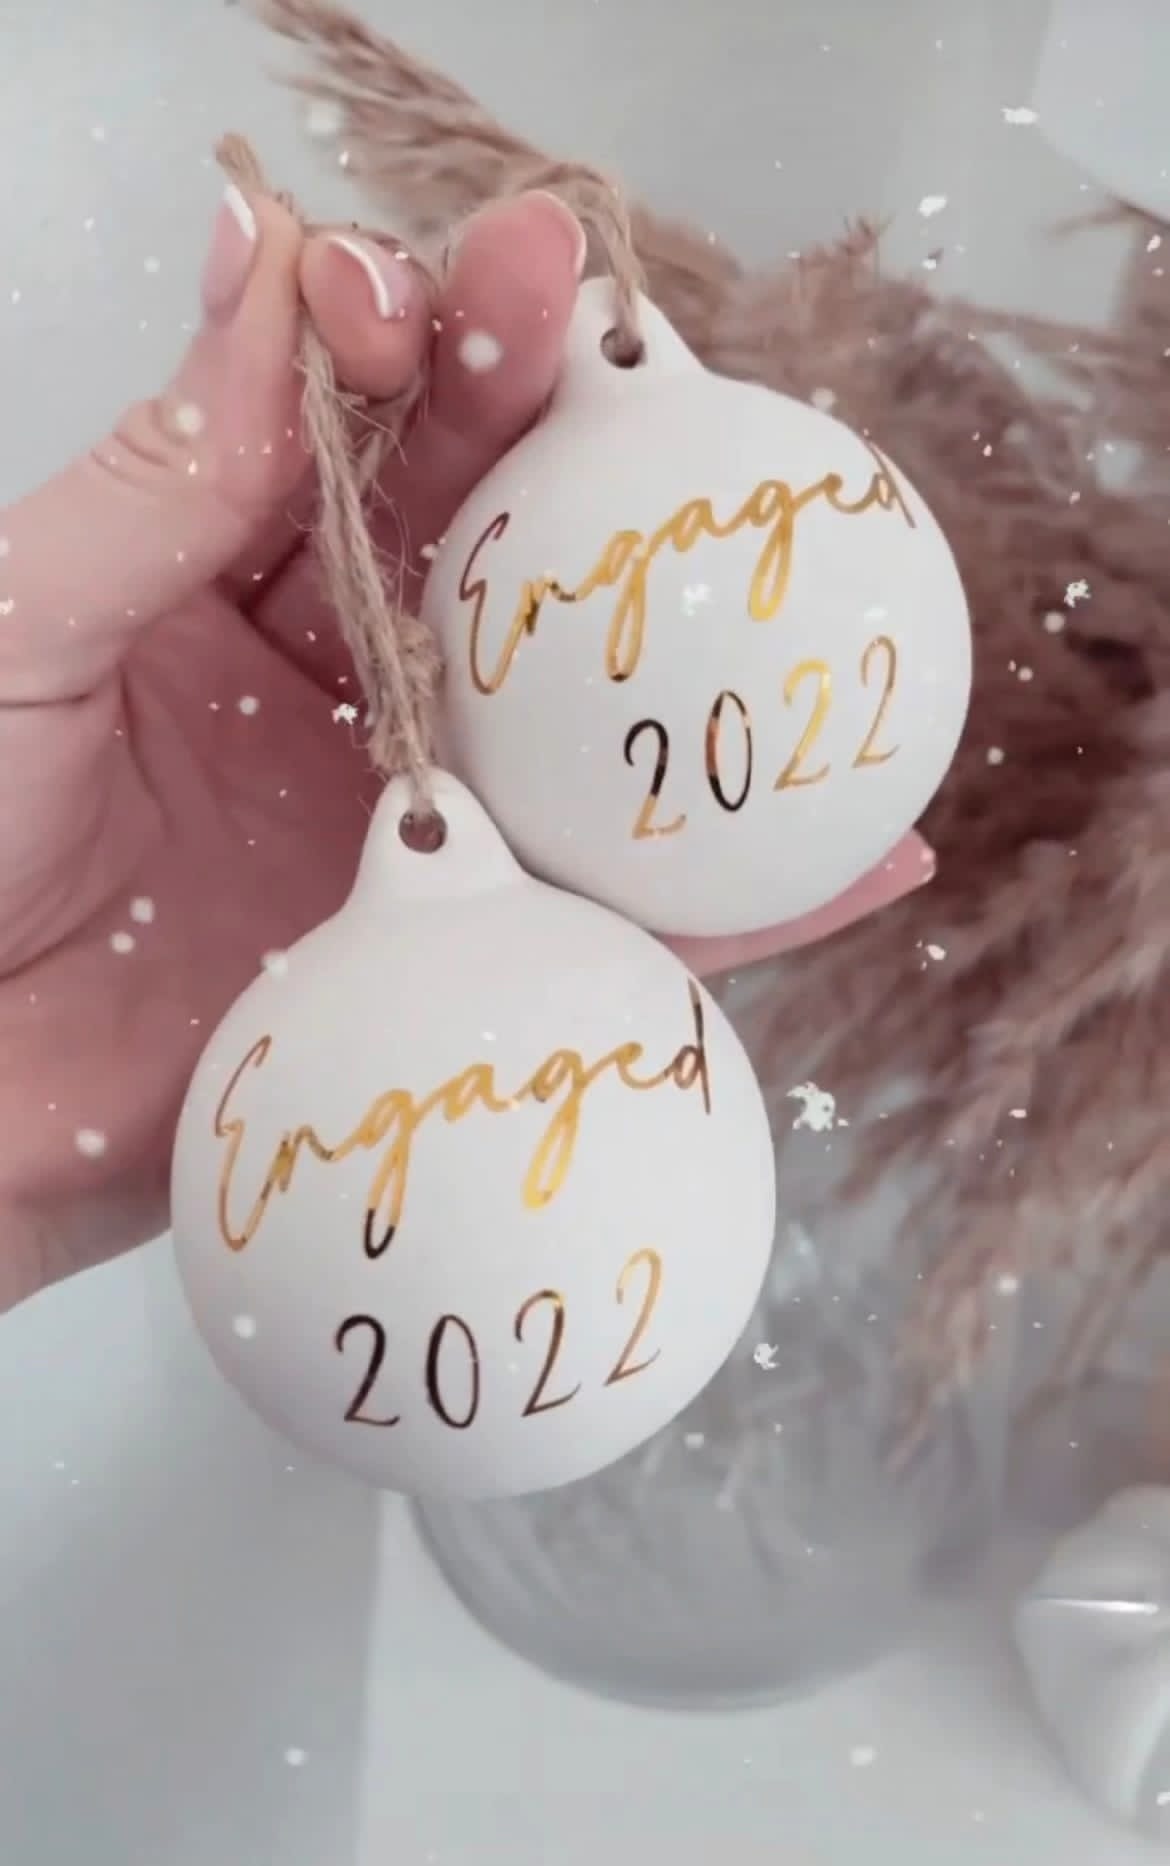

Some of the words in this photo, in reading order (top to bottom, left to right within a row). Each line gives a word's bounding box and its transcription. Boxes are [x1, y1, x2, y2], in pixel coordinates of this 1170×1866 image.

[458, 441, 916, 695] Engaged
[623, 635, 899, 840] 2022
[214, 977, 711, 1259] Engaged
[335, 1248, 662, 1429] 2022
